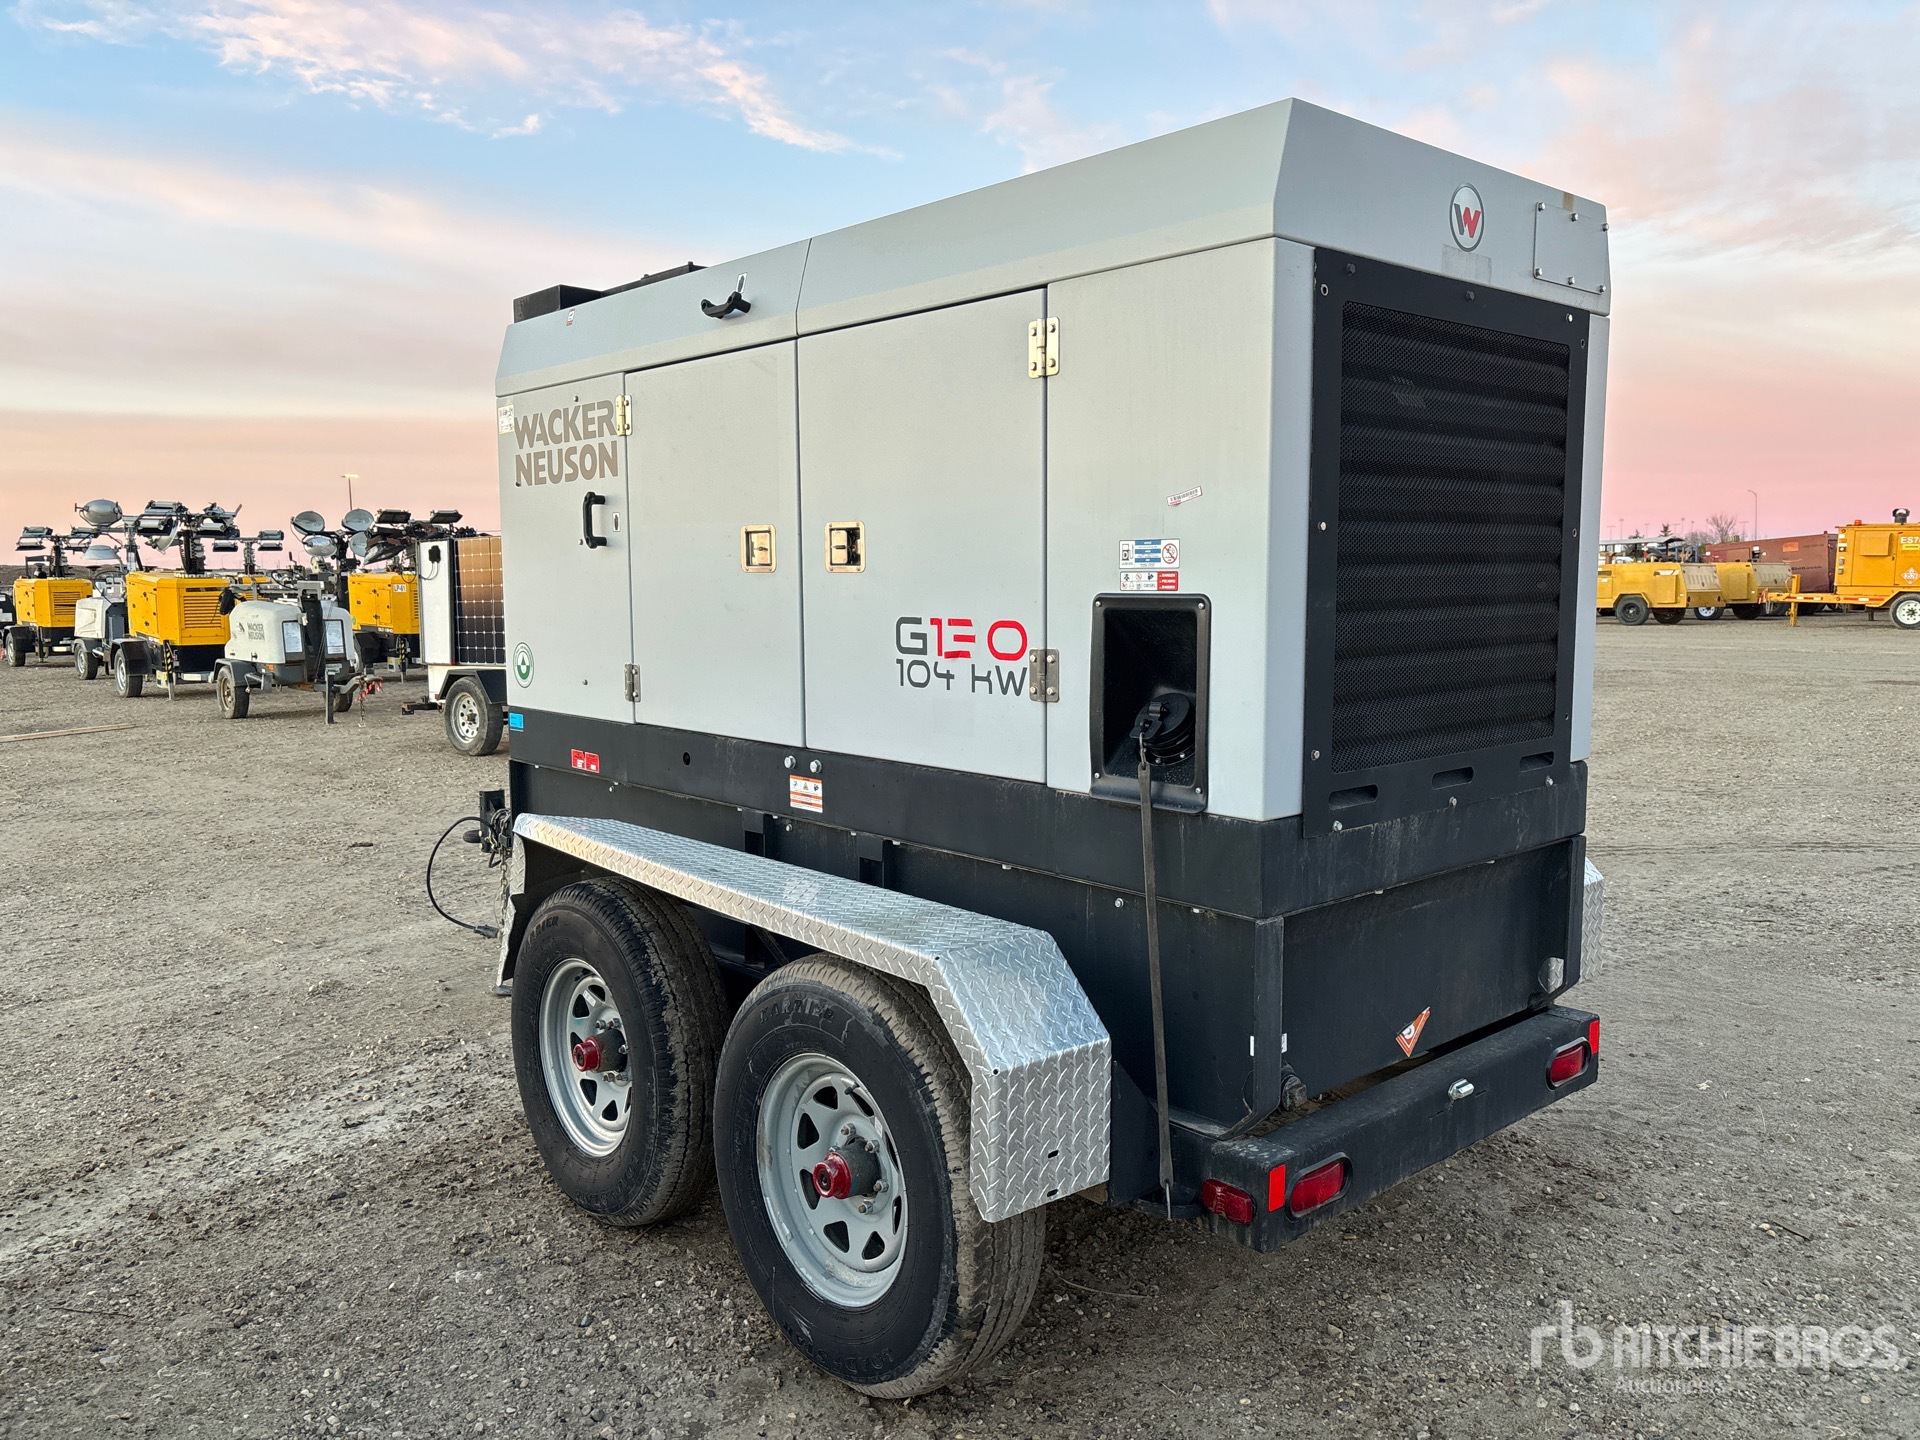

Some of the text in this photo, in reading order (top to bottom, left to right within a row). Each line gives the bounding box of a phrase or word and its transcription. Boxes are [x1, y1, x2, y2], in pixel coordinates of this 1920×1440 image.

[514, 399, 617, 450] WACKER
[515, 440, 618, 487] NEUSON
[1900, 536, 1920, 544] ES7
[247, 622, 264, 632] WACKER
[248, 630, 265, 641] NEUSON
[896, 658, 955, 691] 104
[760, 997, 835, 1024] KARRIER
